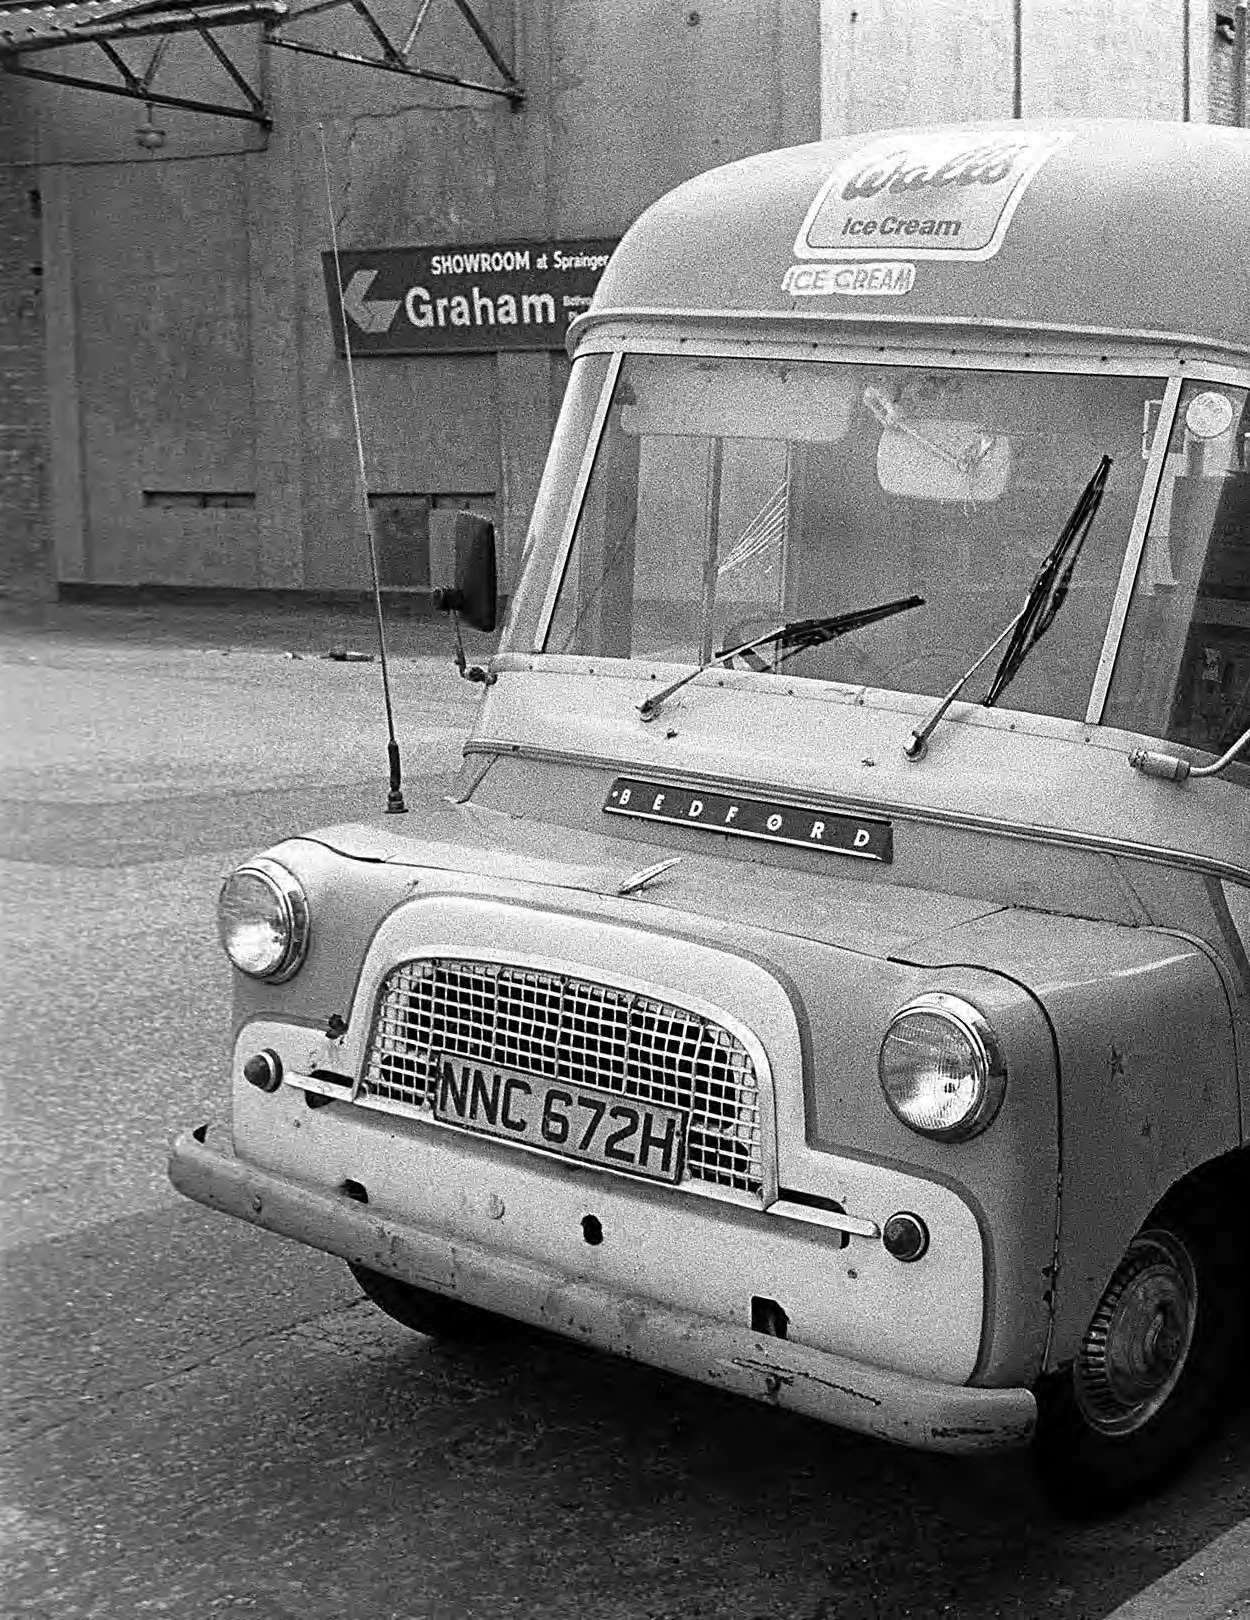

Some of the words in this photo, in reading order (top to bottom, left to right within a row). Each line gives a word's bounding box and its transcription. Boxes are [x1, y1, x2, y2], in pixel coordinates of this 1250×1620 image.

[841, 216, 877, 236] Ice
[878, 215, 962, 236] Cream
[430, 251, 530, 275] SHOWROOM
[535, 254, 548, 270] at
[787, 268, 828, 292] ICE
[833, 267, 912, 292] CREAM
[405, 286, 556, 328] Graham
[618, 788, 870, 848] BEDFORD
[439, 1061, 532, 1132] NNC
[541, 1089, 676, 1173] 672H
